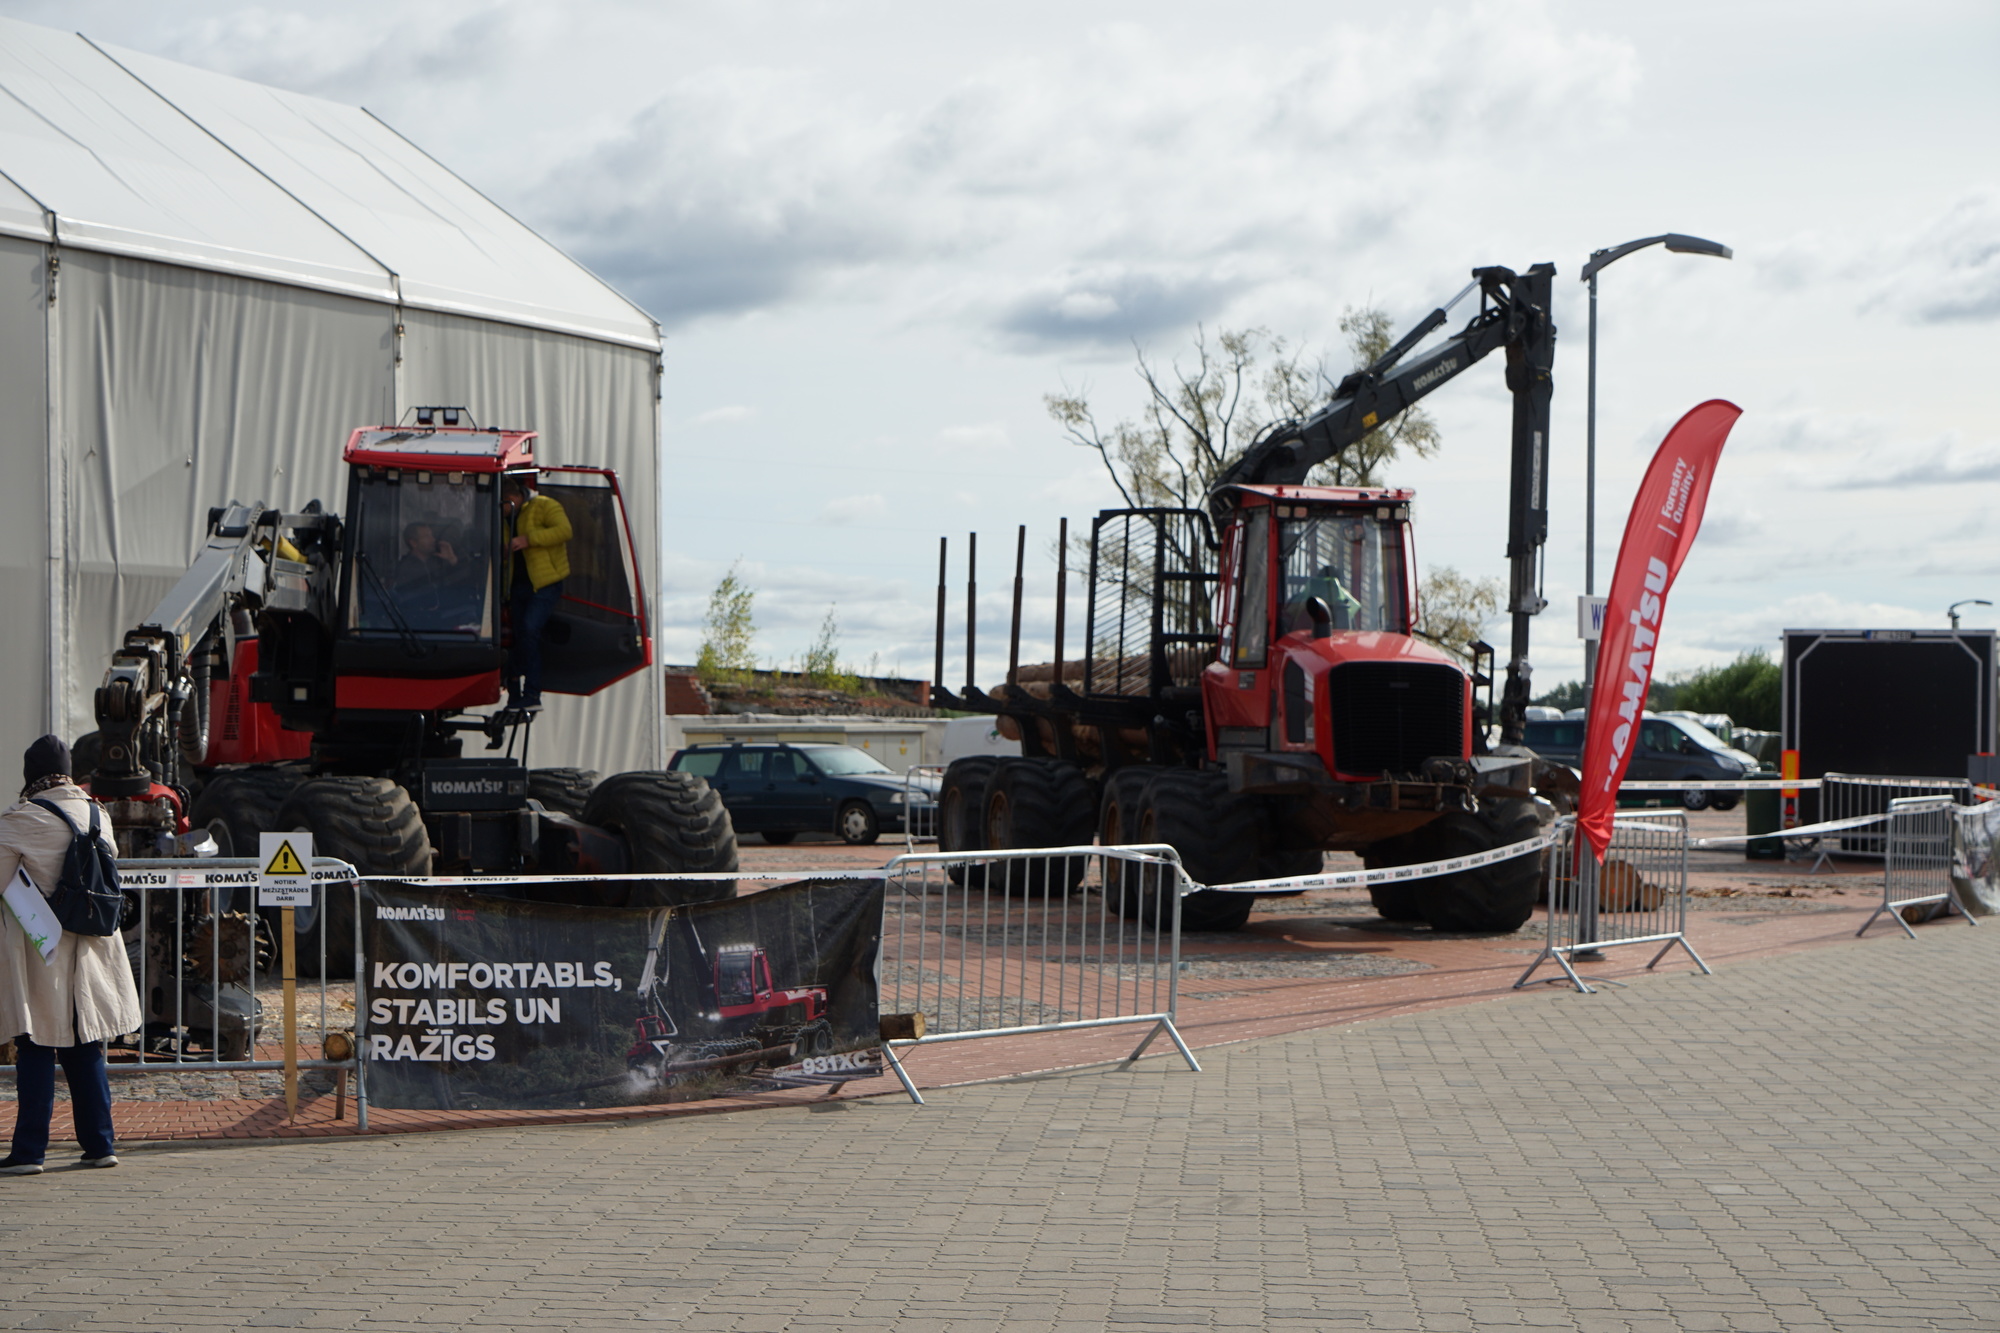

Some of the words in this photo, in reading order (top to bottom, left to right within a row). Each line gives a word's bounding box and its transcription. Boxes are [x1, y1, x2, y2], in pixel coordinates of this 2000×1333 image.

[1413, 357, 1457, 391] KOMATSU
[1661, 457, 1686, 518] Forestry
[431, 778, 503, 794] KOMATSU
[205, 870, 260, 883] KOMATS
[377, 904, 445, 920] KOMATSU
[373, 961, 622, 992] KOMFORTABLS,
[370, 998, 507, 1025] STABILS
[515, 997, 561, 1024] UN
[370, 1029, 496, 1062] RAŽĪGS
[802, 1051, 870, 1075] 931XC
